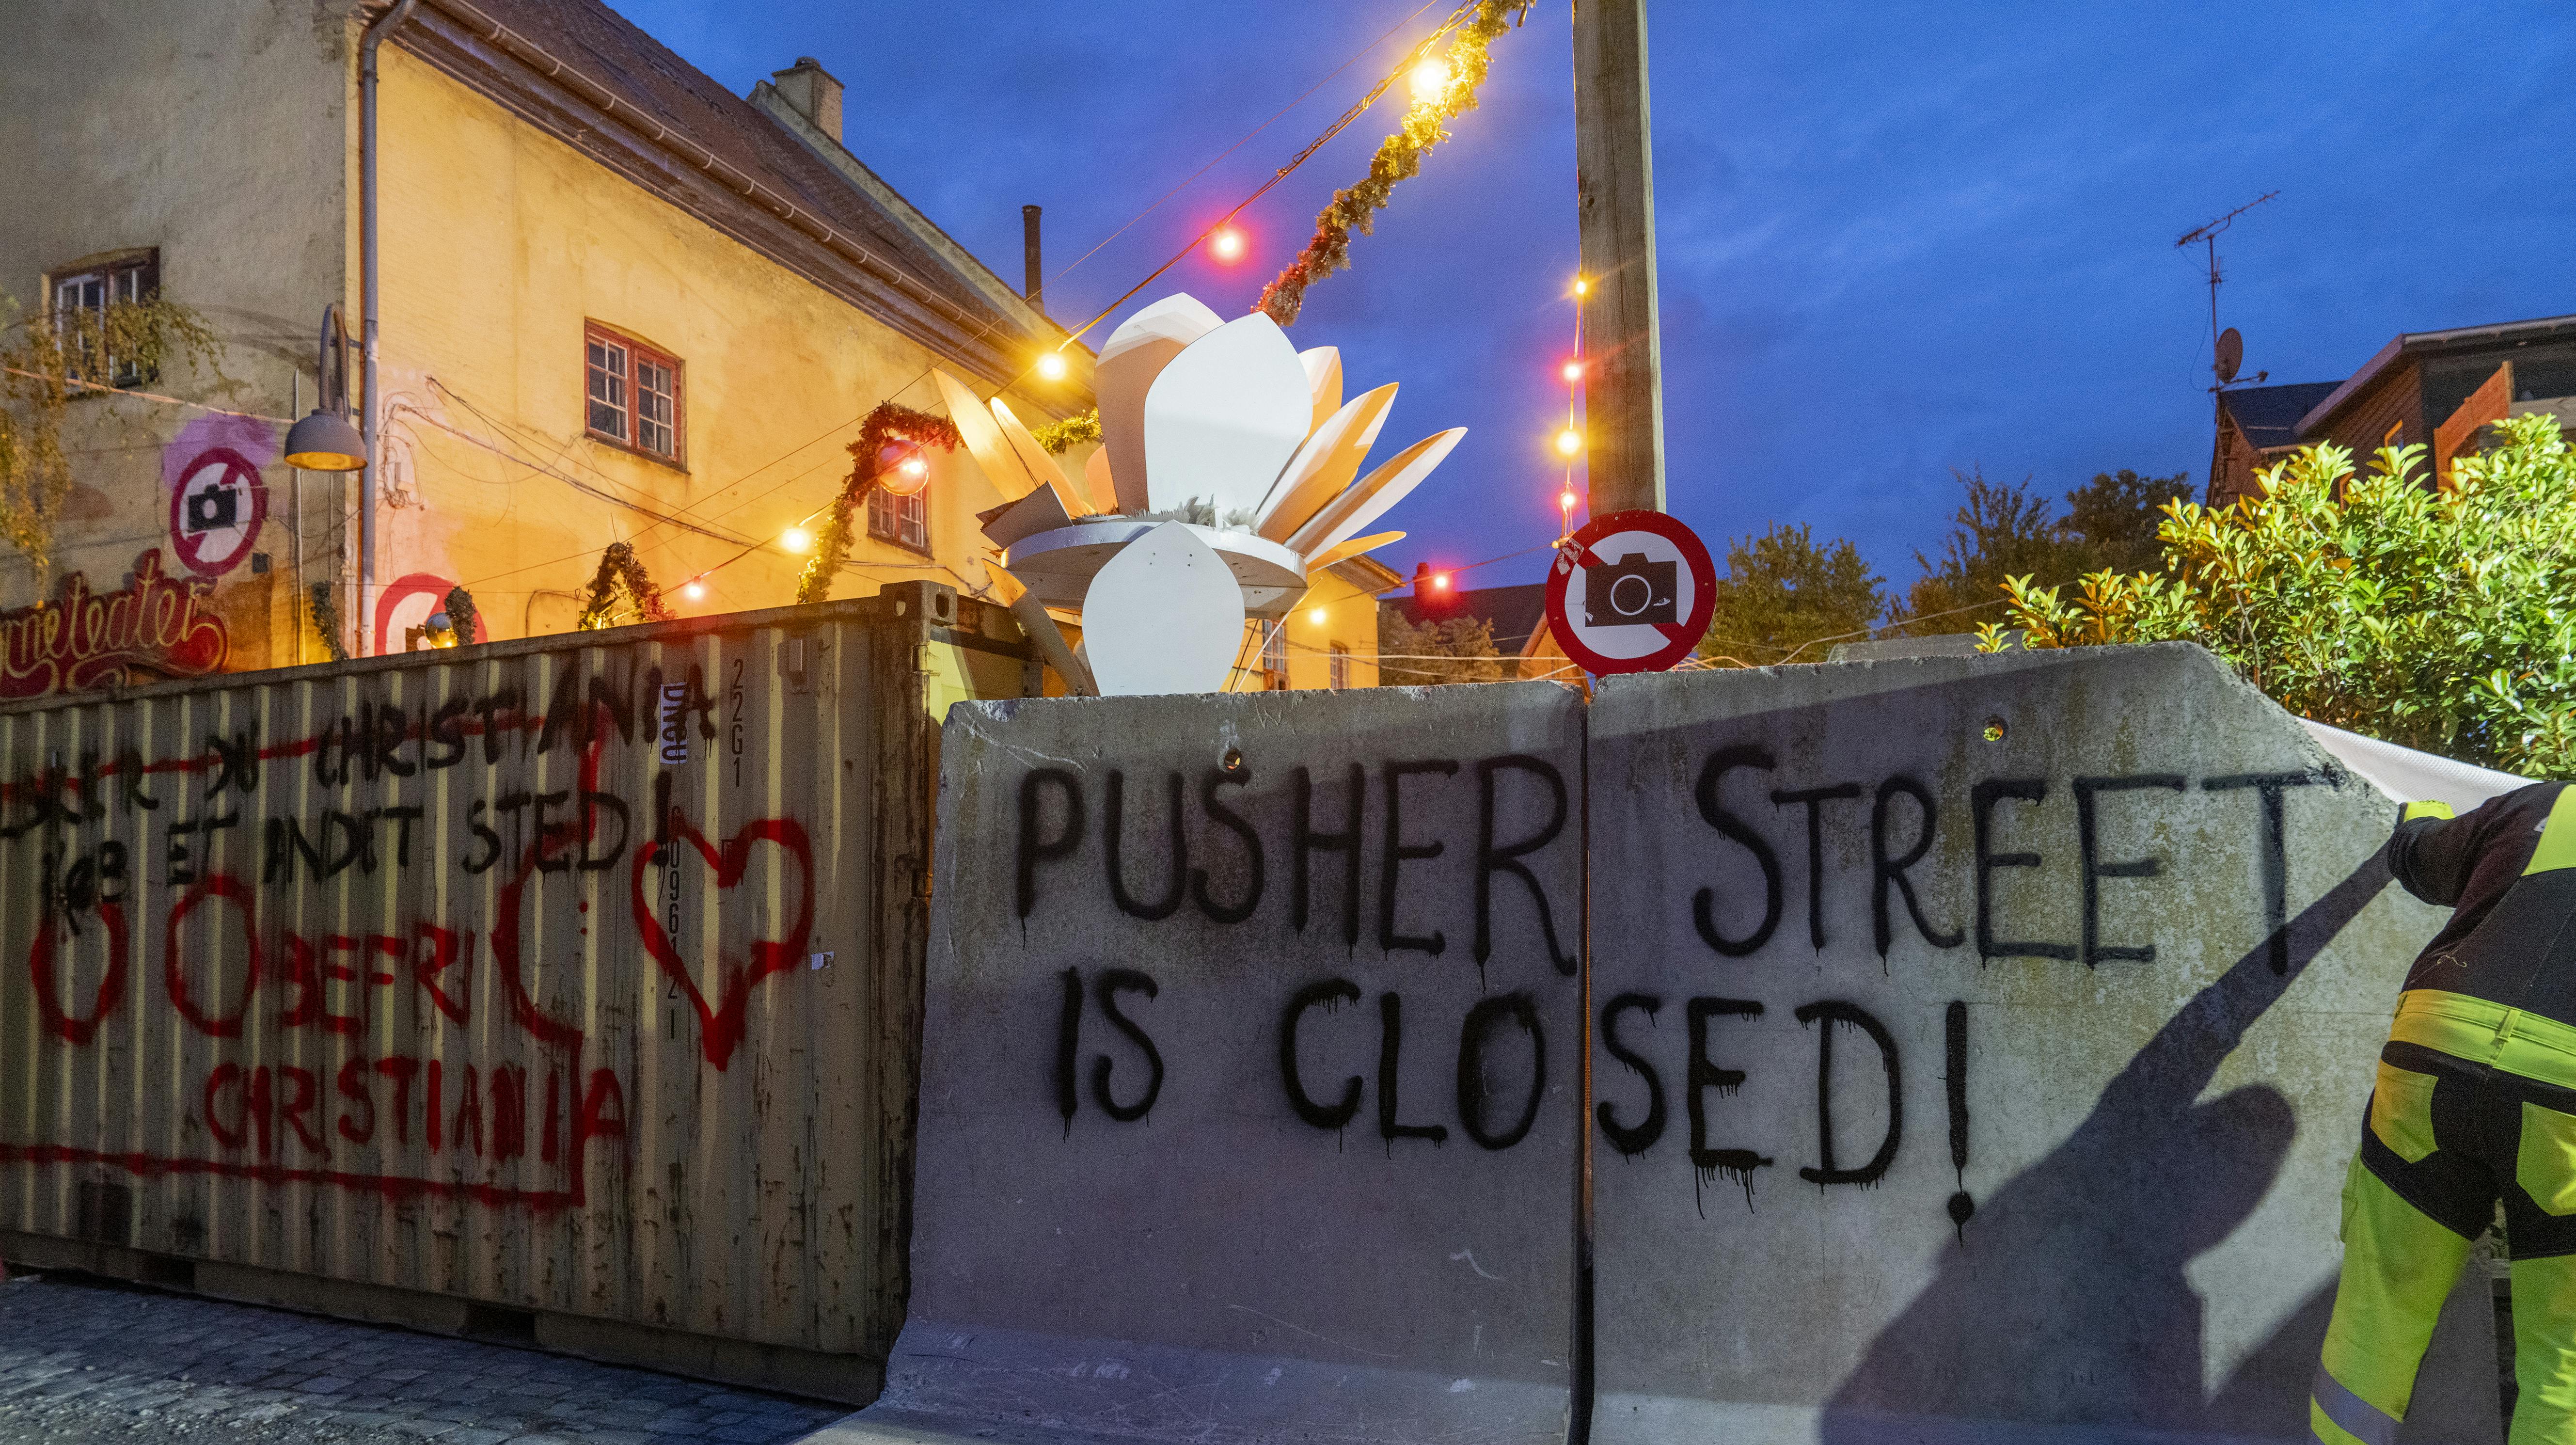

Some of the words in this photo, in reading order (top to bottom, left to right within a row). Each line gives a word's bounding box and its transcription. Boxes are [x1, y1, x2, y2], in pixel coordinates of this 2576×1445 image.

[0, 556, 211, 676] rneteater
[731, 658, 744, 788] 22G1
[1015, 753, 1577, 975] PUSHER
[1694, 744, 2342, 975] STREET
[282, 923, 477, 1033] BEFRI
[206, 1056, 626, 1162] CHRISTIANIA
[1060, 967, 1163, 1127] IS
[1280, 977, 1975, 1226] CLOSED!
